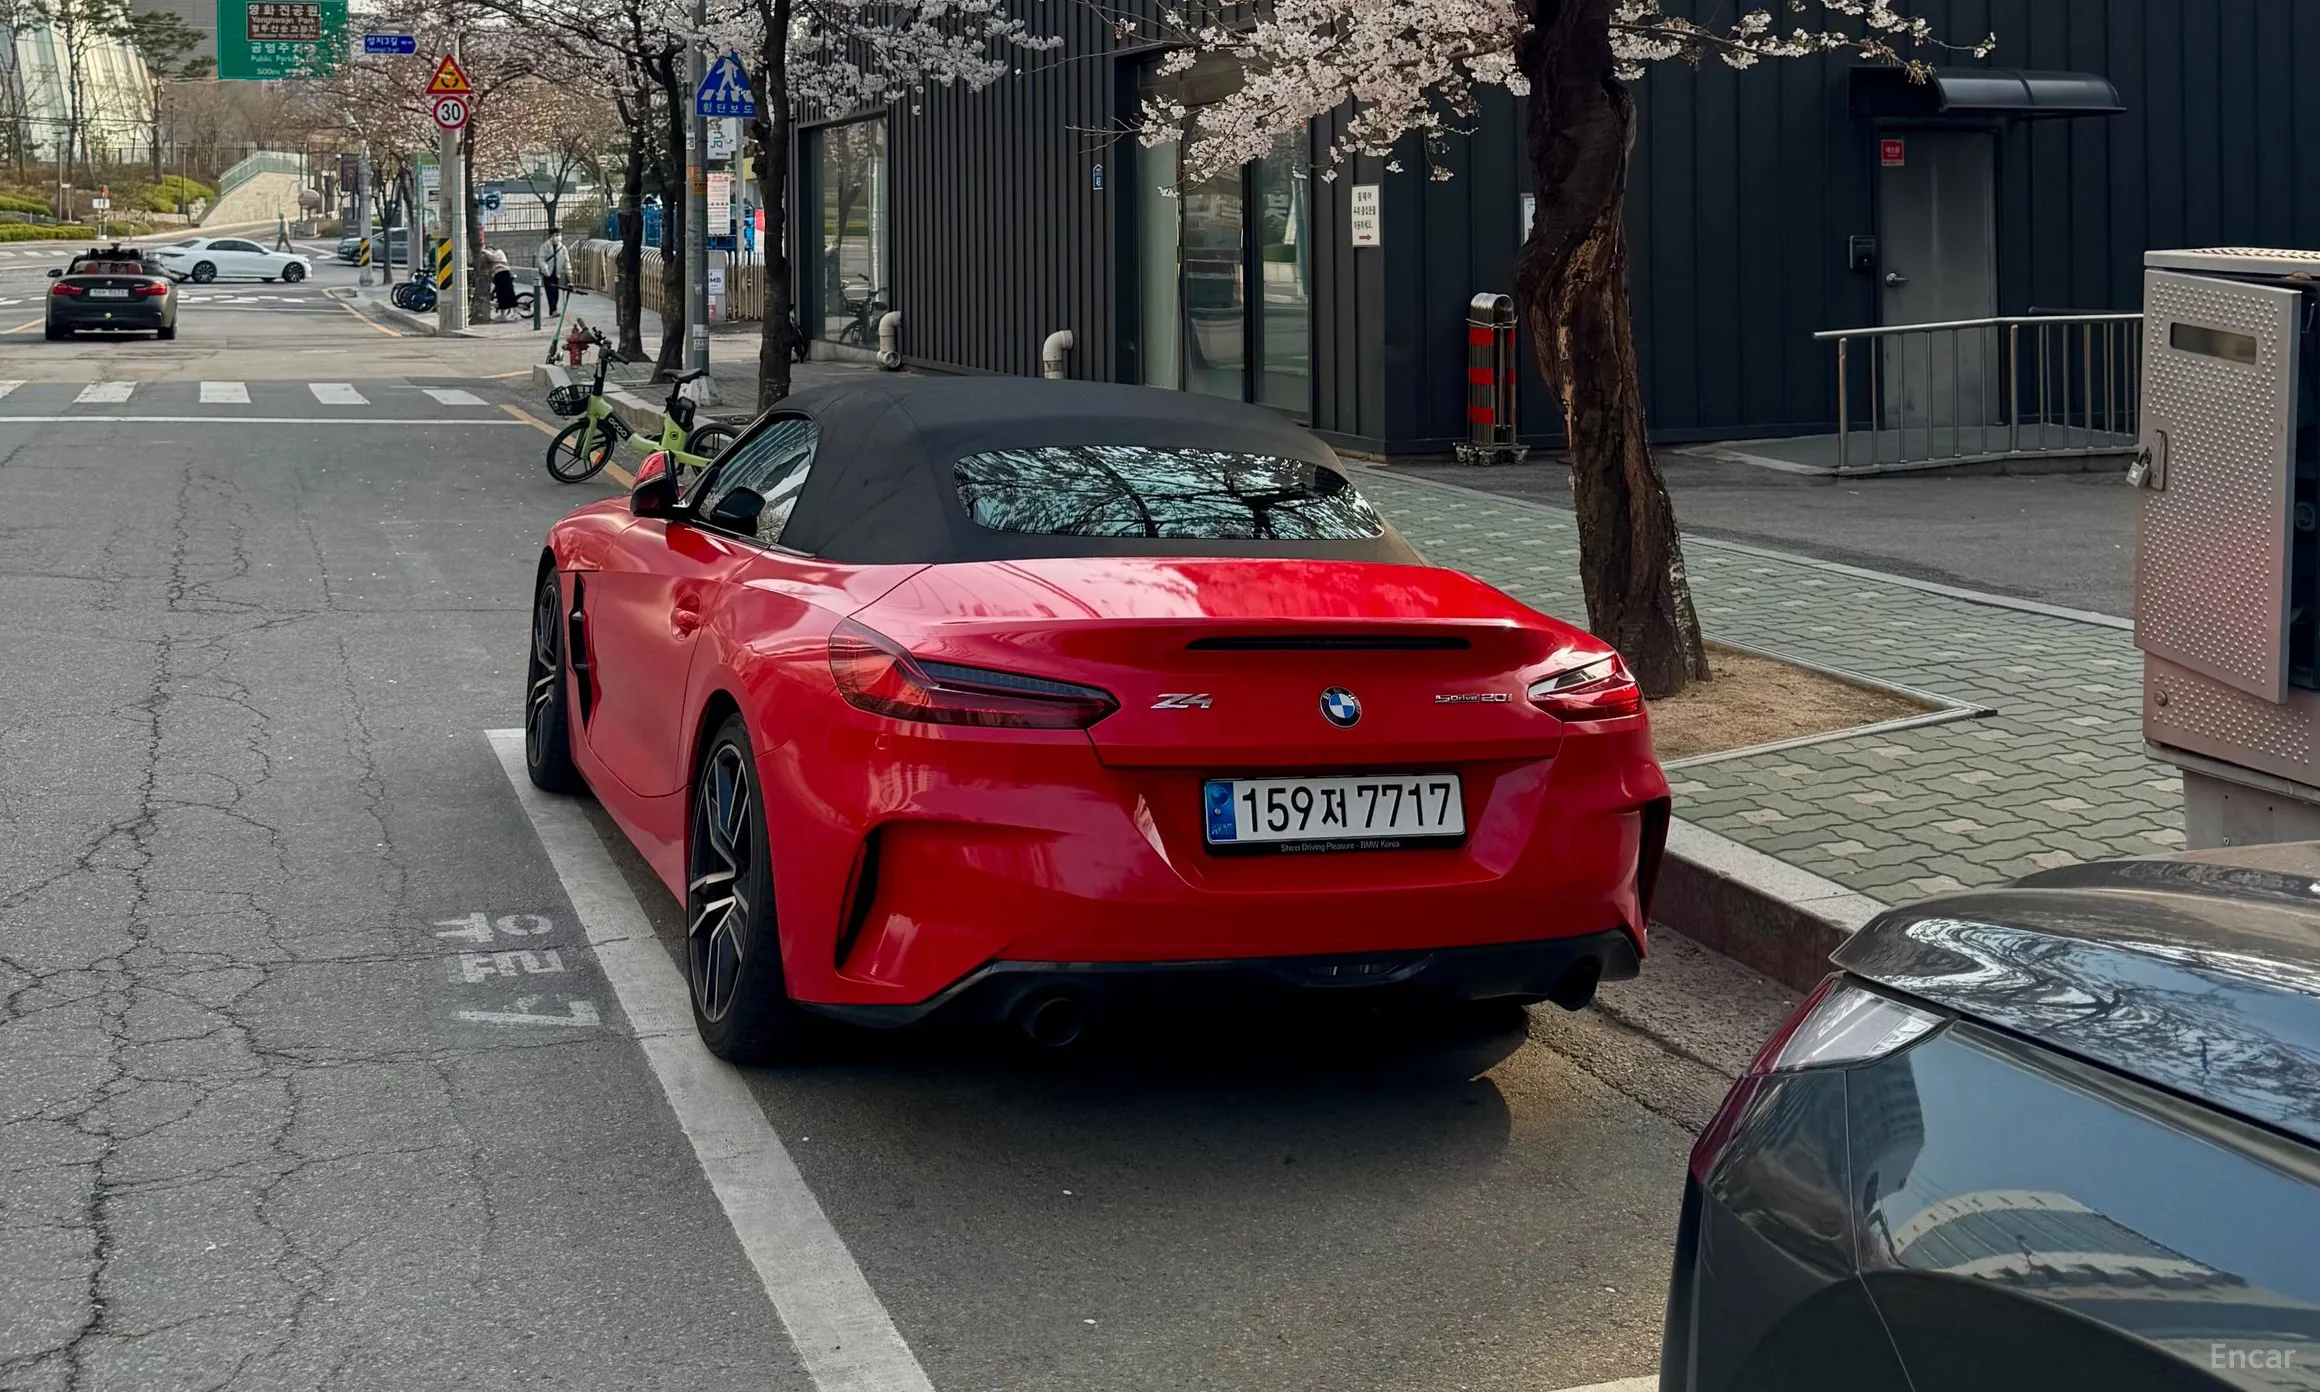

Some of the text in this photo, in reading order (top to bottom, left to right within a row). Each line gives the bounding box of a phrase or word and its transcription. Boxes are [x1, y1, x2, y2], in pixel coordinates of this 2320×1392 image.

[249, 4, 318, 16] 양화진공원
[441, 103, 461, 121] 30
[703, 102, 753, 114] 횡단보도
[1151, 693, 1213, 709] Z4
[1357, 782, 1451, 828] 7717
[1280, 840, 1400, 853] Sheer Driving Pleasure BMW Korea
